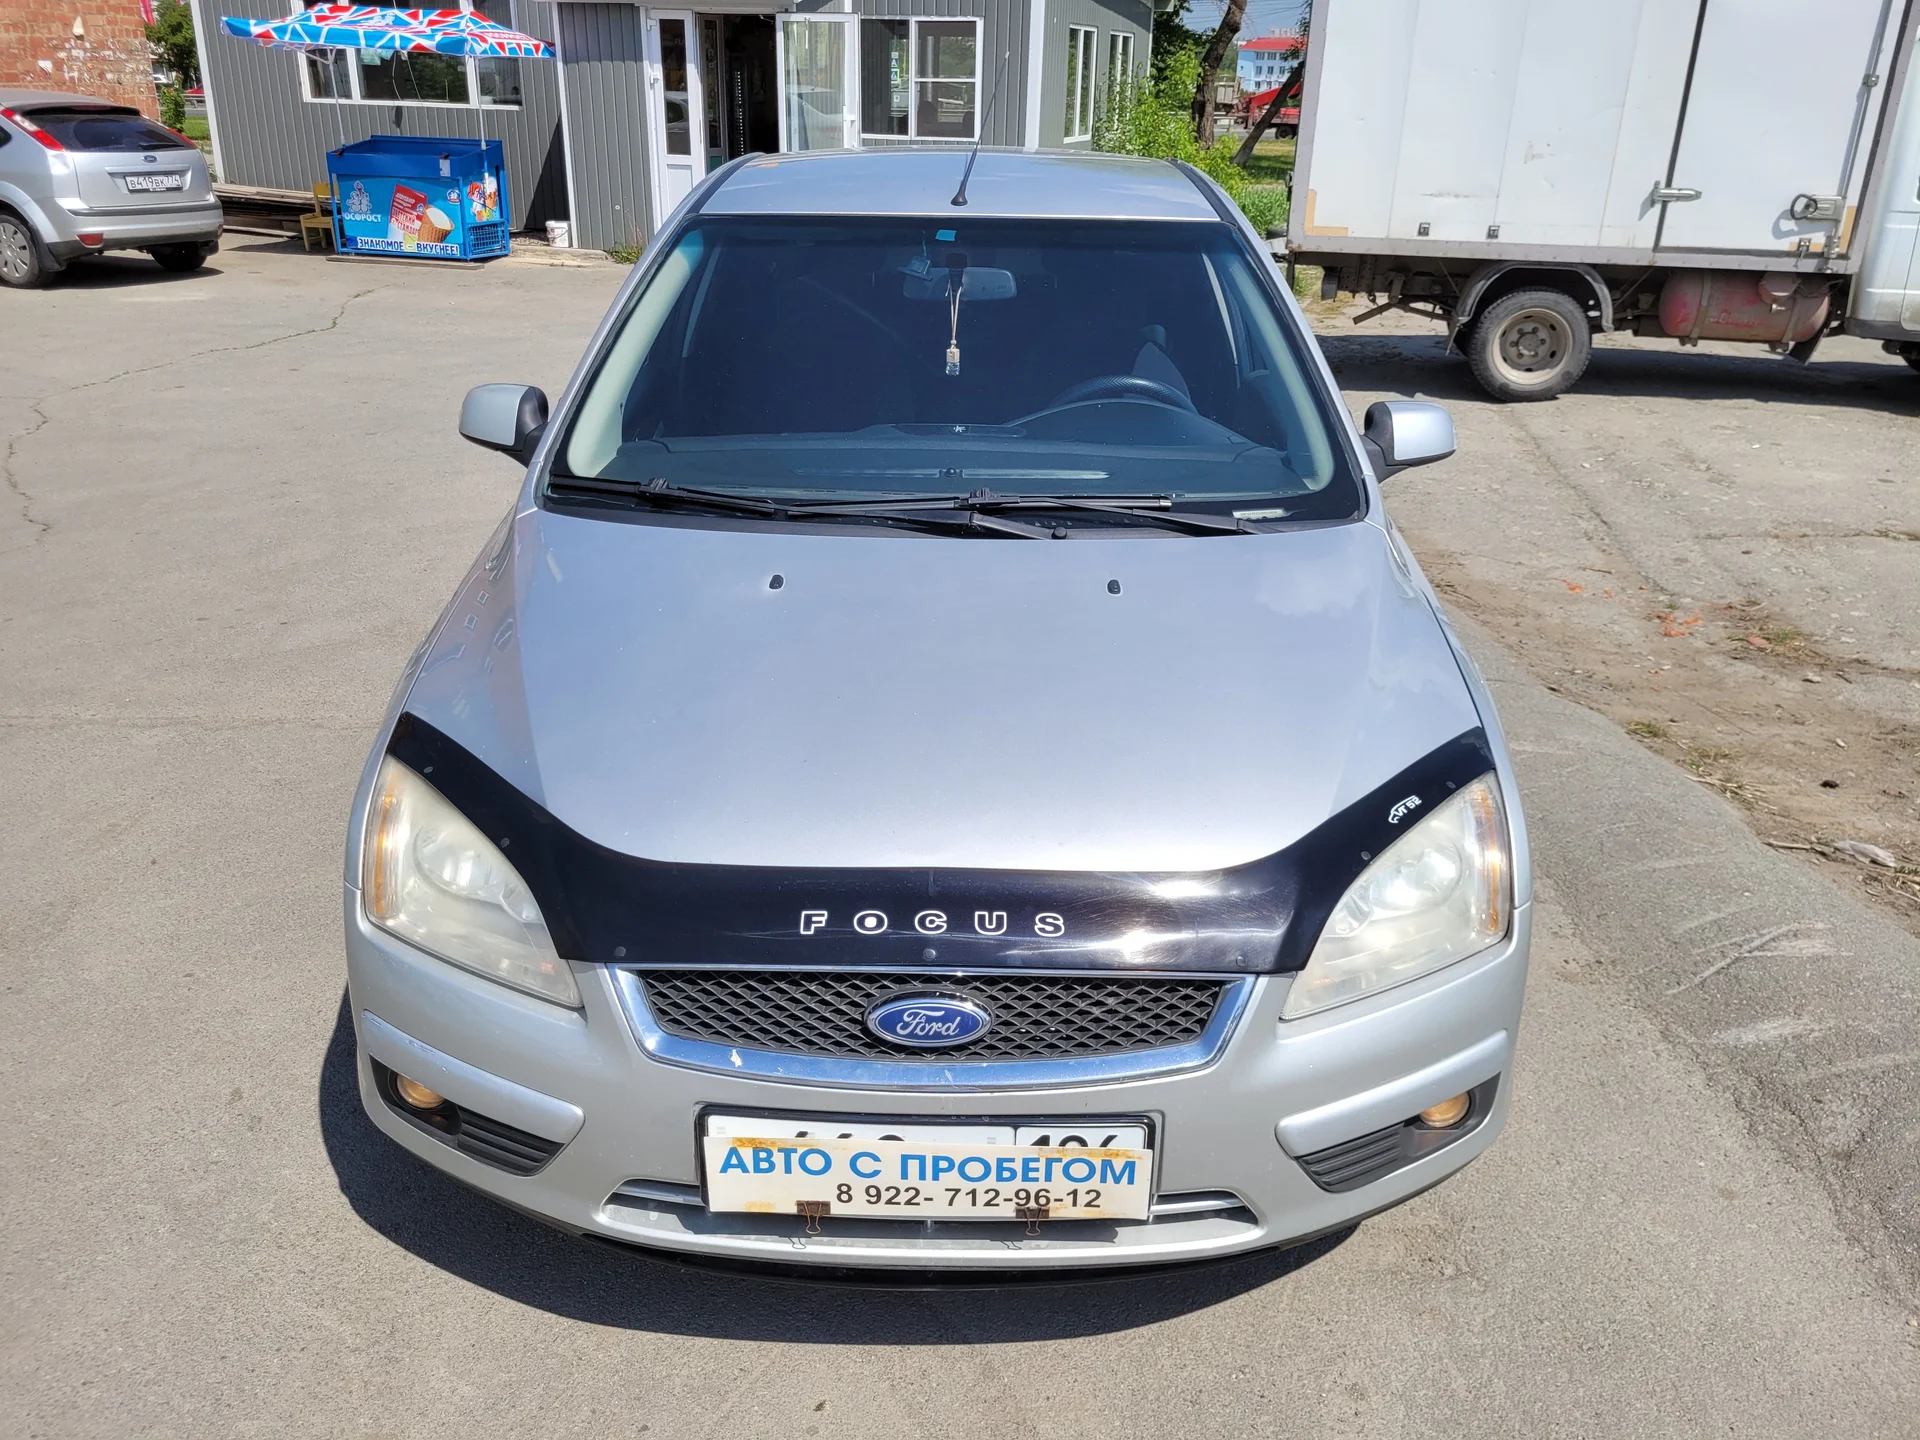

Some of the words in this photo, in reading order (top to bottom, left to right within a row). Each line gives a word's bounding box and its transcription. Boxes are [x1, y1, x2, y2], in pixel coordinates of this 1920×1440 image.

[358, 238, 404, 251] ЗНАКОМОЕ
[416, 242, 459, 256] ВКУСНЕЕ!
[800, 910, 1065, 938] FOCUS
[896, 1008, 961, 1037] Ford
[719, 1146, 833, 1177] АВТО
[849, 1150, 883, 1179] С
[900, 1153, 1137, 1186] ПРОБЕГОМ
[835, 1182, 853, 1204] 8
[864, 1184, 934, 1207] 922-
[944, 1187, 1103, 1209] 712-96-12
